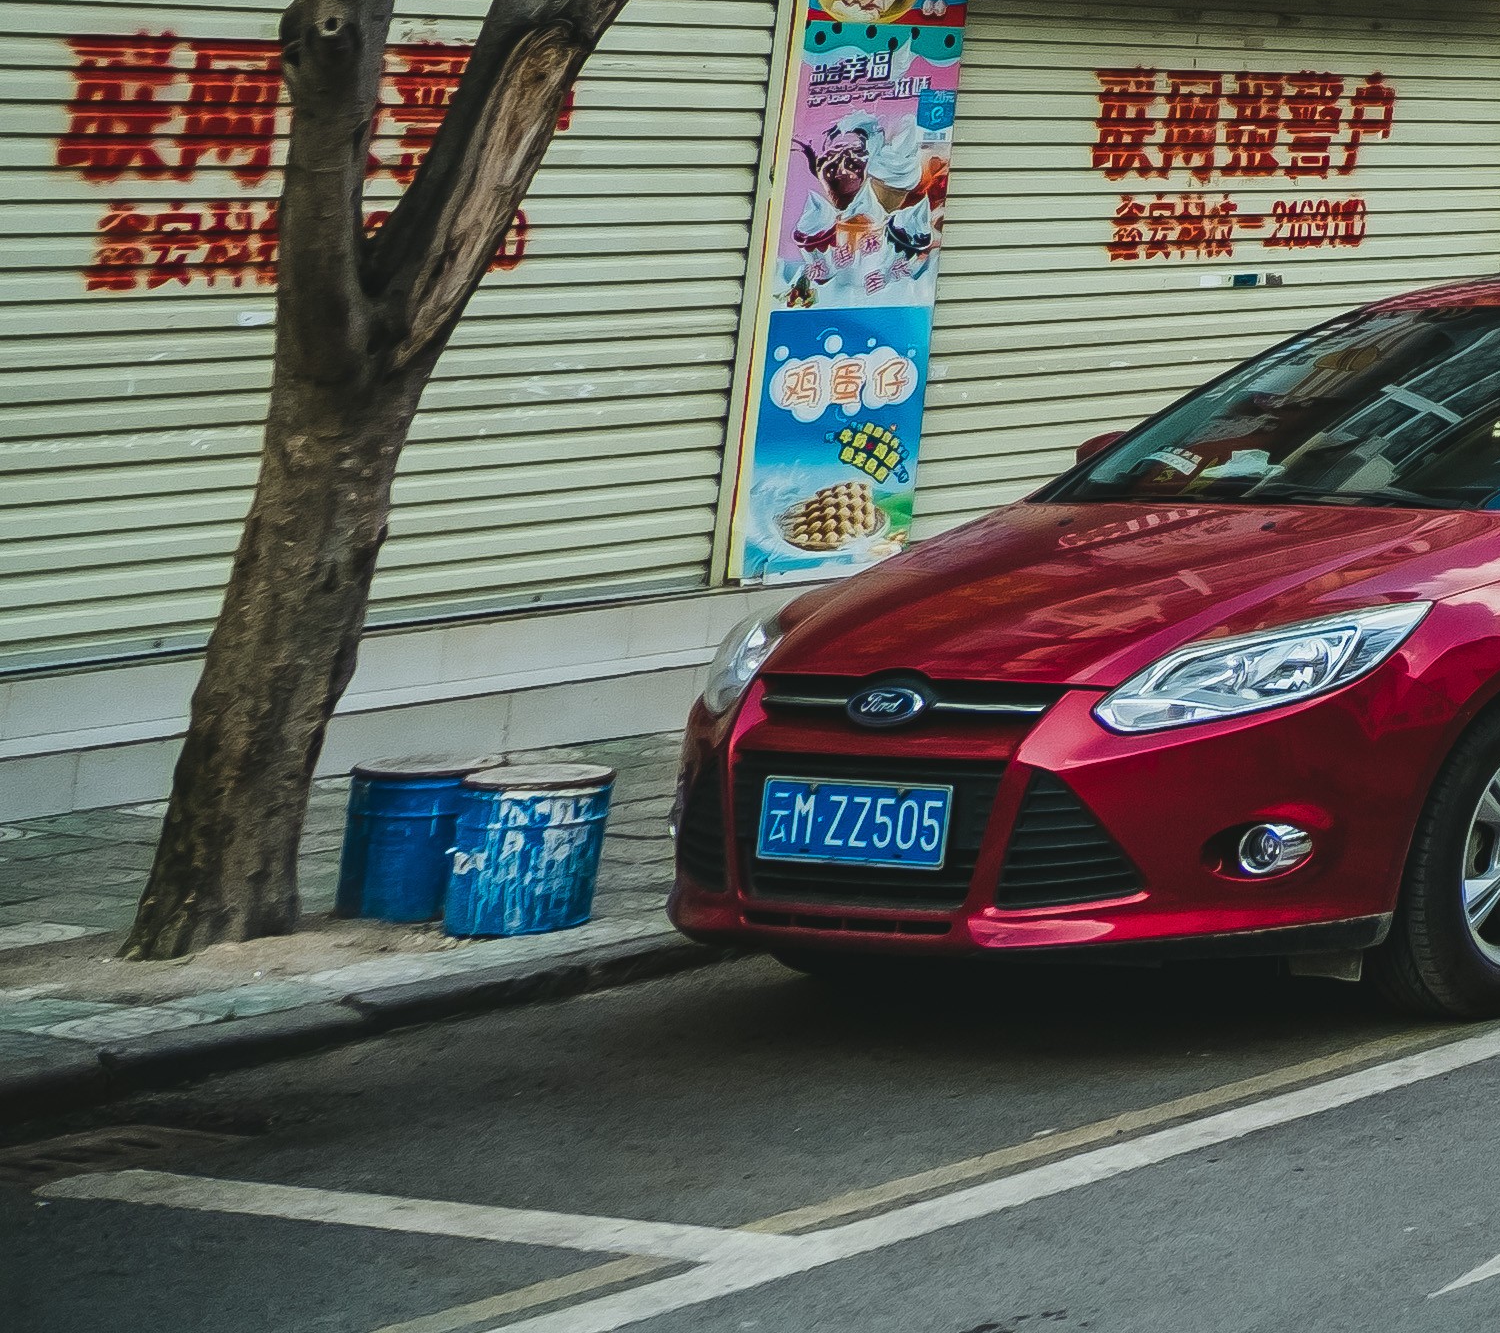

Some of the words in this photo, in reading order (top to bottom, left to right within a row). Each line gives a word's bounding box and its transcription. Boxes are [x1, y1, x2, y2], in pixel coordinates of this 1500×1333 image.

[1092, 67, 1396, 181] 联网报警户
[782, 358, 908, 408] 鸡蛋仔
[860, 692, 904, 713] Ford
[768, 791, 944, 852] 云M·ZZ505
